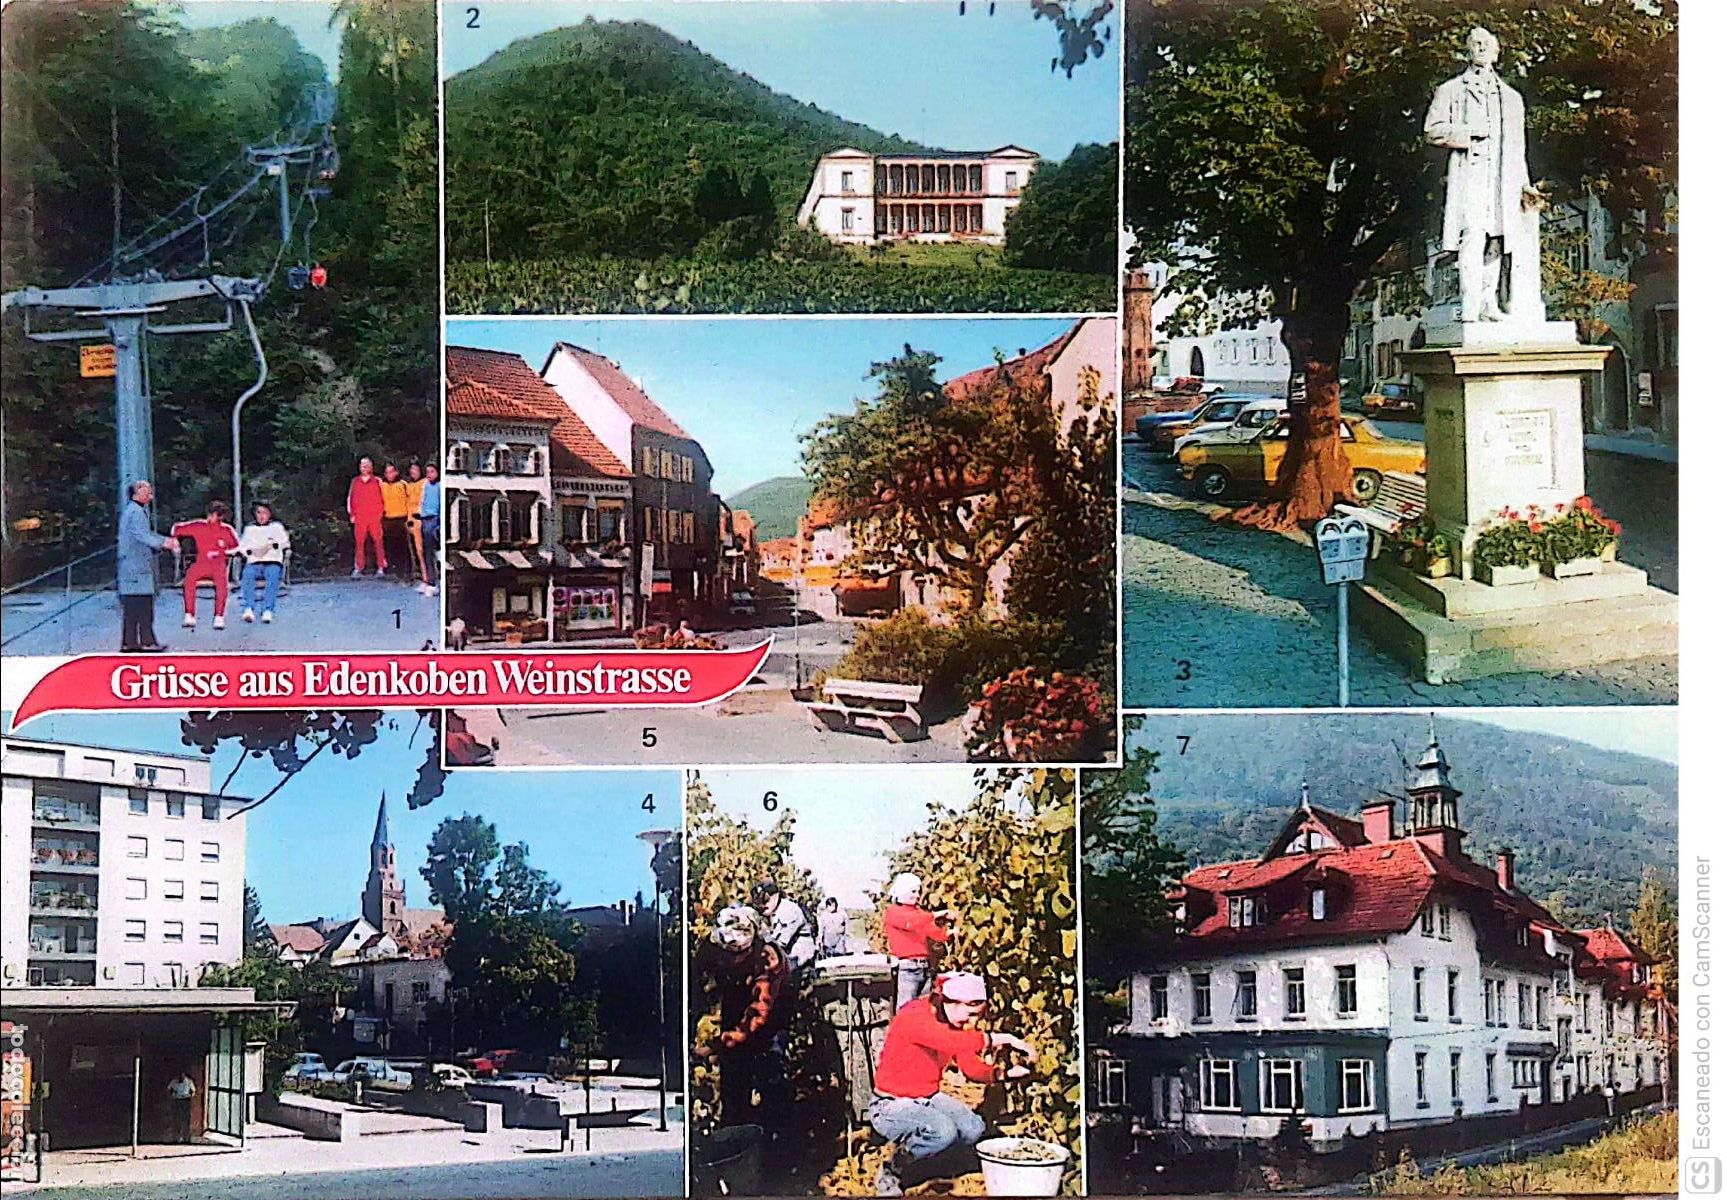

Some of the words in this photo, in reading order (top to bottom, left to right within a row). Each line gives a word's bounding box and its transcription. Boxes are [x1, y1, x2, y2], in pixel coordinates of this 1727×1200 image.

[466, 8, 480, 29] 2
[391, 609, 401, 629] 1
[112, 661, 229, 700] Grüsse
[239, 672, 294, 698] aus
[303, 661, 487, 698] Edenkoben
[493, 659, 692, 697] Weinstrasse
[1173, 660, 1191, 680] 3
[642, 727, 657, 748] 5
[1176, 735, 1191, 756] 7
[641, 793, 657, 814] 4
[763, 790, 778, 812] 6
